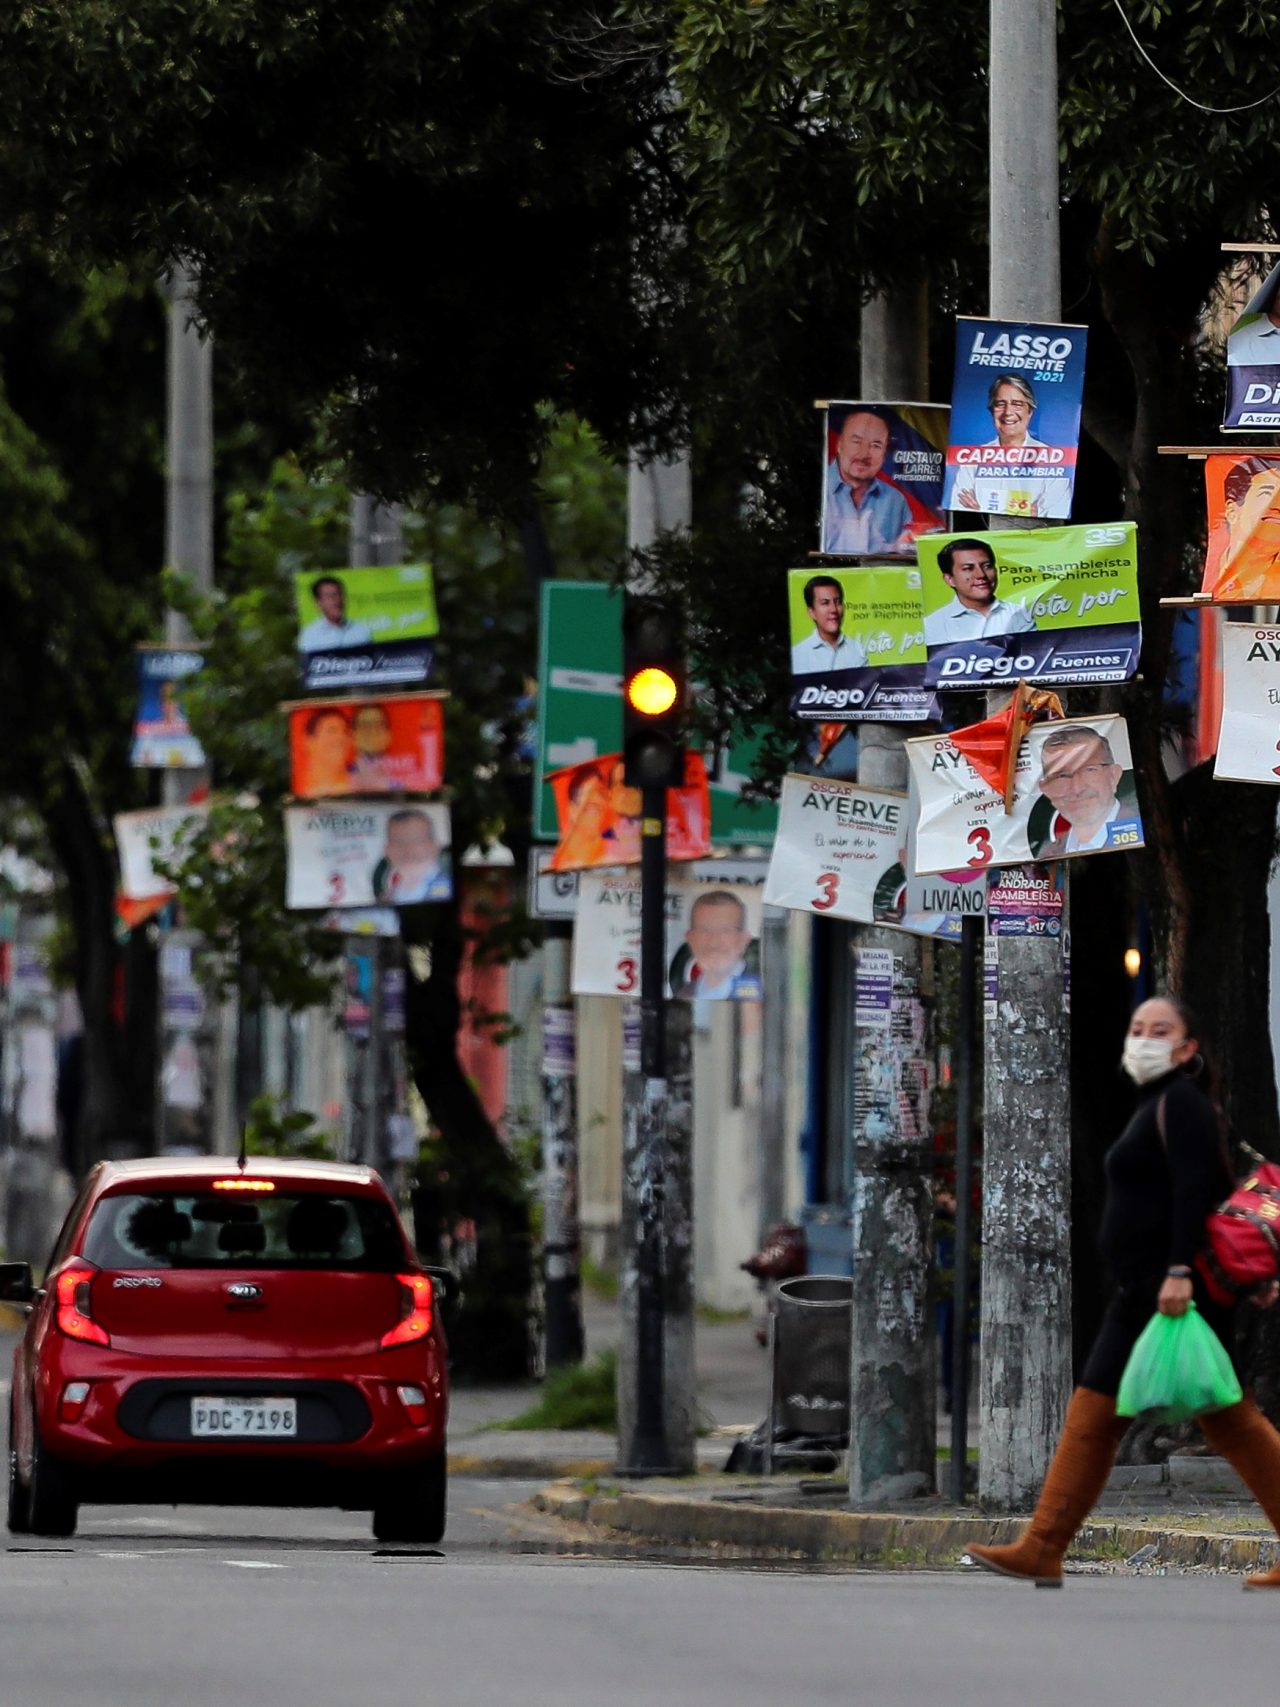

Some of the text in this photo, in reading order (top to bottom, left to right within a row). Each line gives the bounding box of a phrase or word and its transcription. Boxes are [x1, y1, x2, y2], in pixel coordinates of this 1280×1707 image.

[972, 332, 1072, 360] LASSO
[969, 354, 1066, 372] PRESIDENTE
[1033, 371, 1065, 382] 2021
[895, 451, 943, 465] GUSTAVO
[956, 448, 1064, 464] CAPACIDAD
[904, 463, 942, 475] LARREA
[977, 467, 1065, 477] PARA CAMBIAR
[893, 474, 941, 482] PRESIDENTE
[1085, 527, 1127, 546] 35
[1000, 558, 1131, 575] Para asambleísta
[907, 571, 922, 587] 3
[1012, 569, 1119, 586] por Pichincha
[846, 600, 922, 610] Para asamble
[1020, 588, 1128, 623] Vota por
[853, 611, 924, 621] por Pichinch
[855, 631, 925, 657] Vota po
[940, 654, 1121, 676] Diego Fuentes
[1053, 672, 1122, 682] Pichincha
[800, 684, 929, 708] Diego Fuentes
[1268, 688, 1280, 704] El
[811, 782, 852, 796] OSCAR
[802, 792, 900, 824] AYERVE
[967, 819, 988, 827] LISTA
[1113, 831, 1138, 846] 30S
[967, 827, 993, 867] 3
[999, 870, 1024, 880] TANIA
[811, 872, 840, 911] 3
[998, 879, 1050, 890] ANDRADE
[923, 889, 984, 912] LIVIANO
[991, 890, 1062, 902] ASAMBLEÍSTA
[1034, 922, 1046, 931] 17
[616, 957, 639, 992] 3
[196, 1410, 293, 1430] PDC-7198
